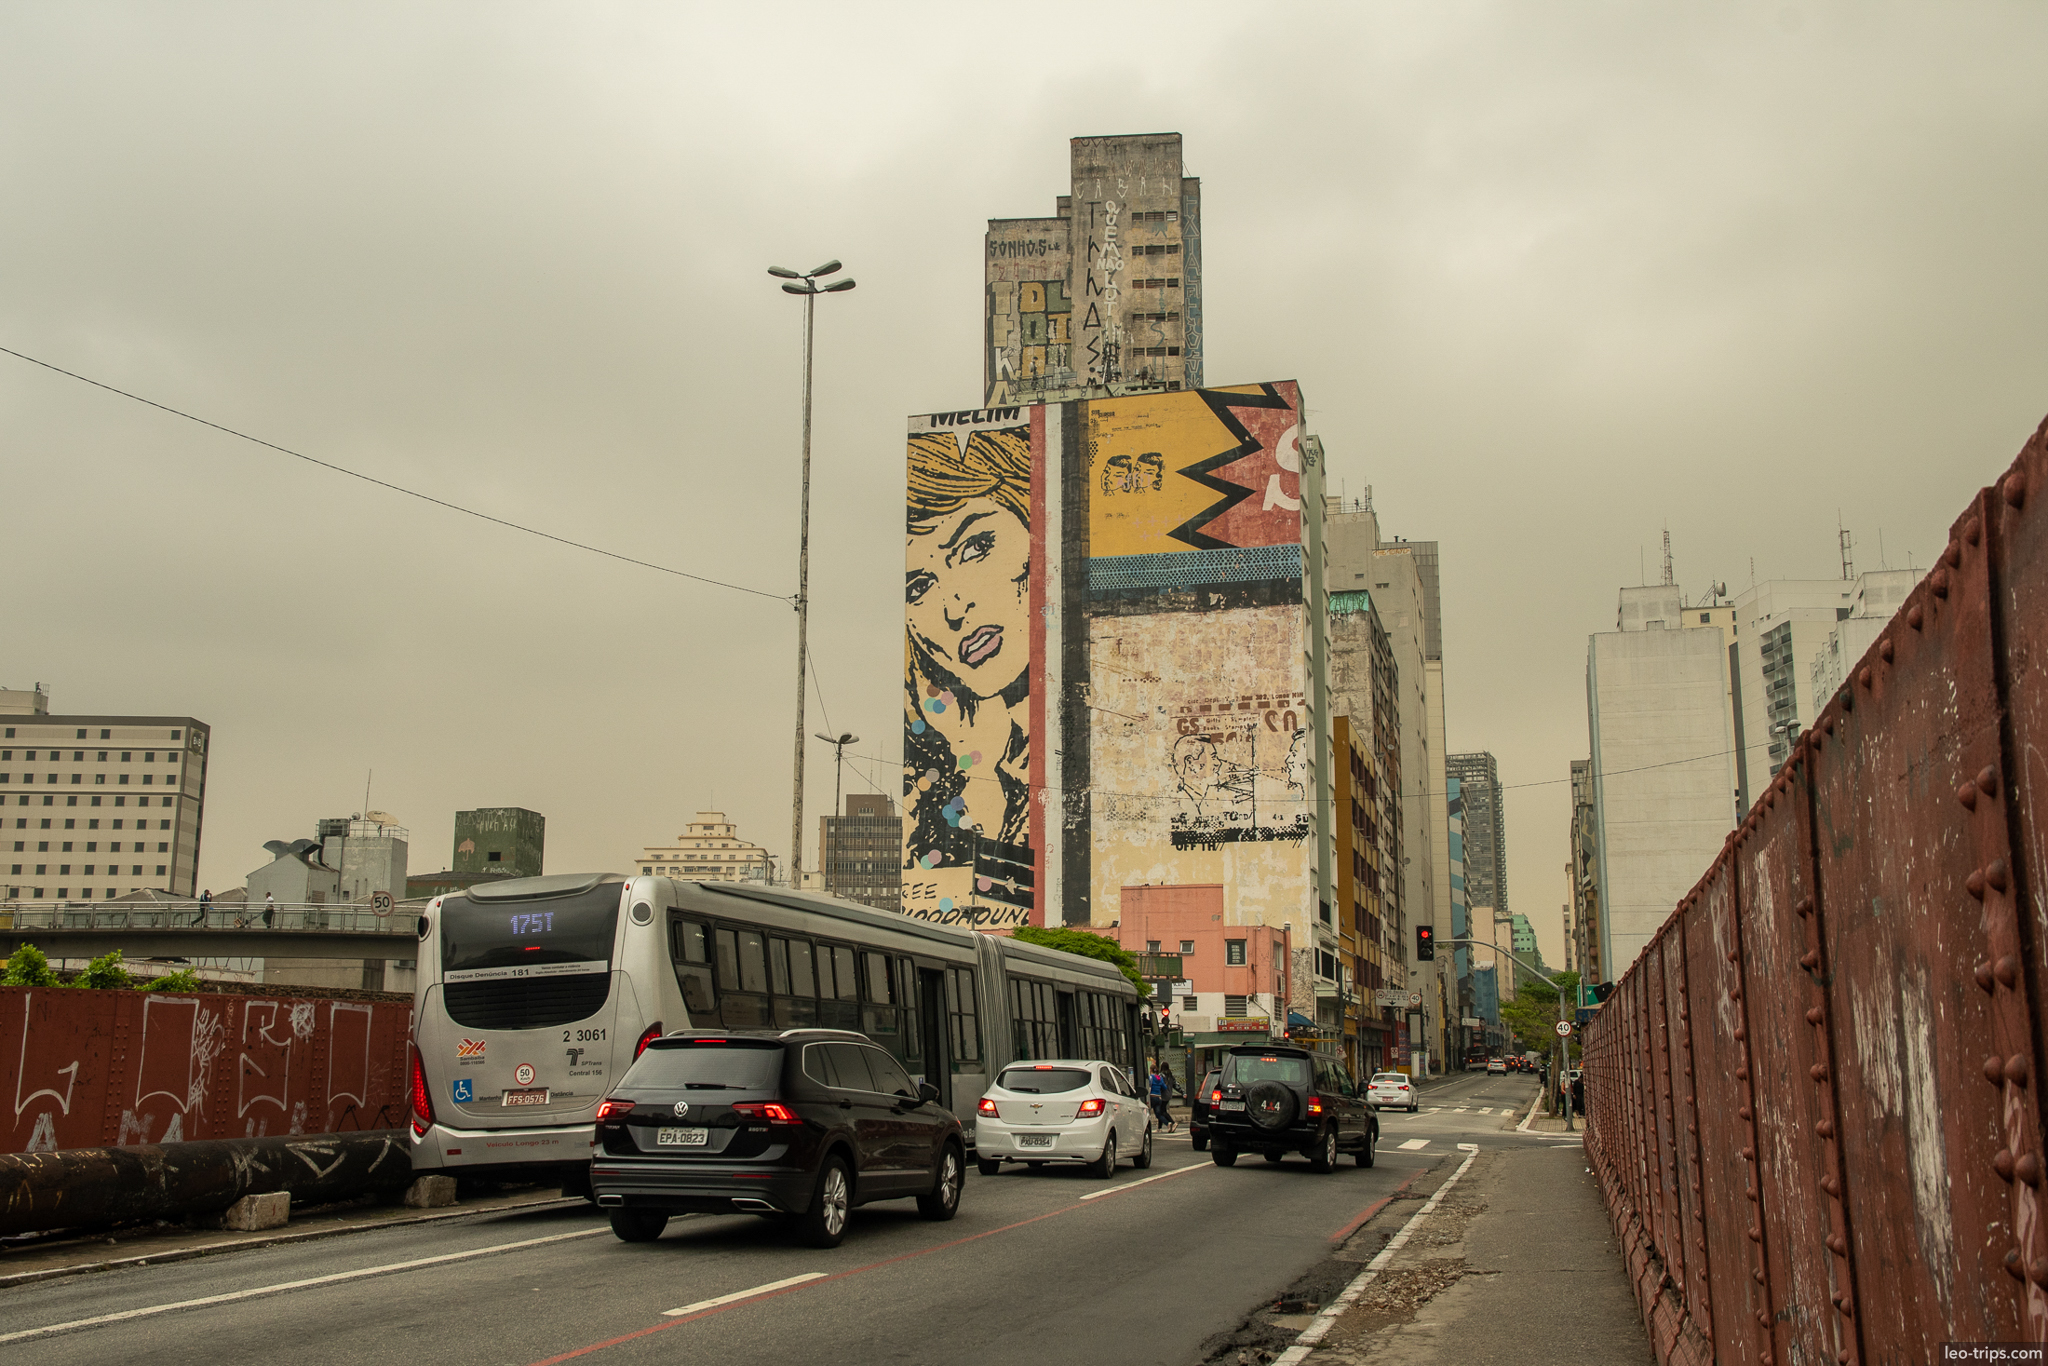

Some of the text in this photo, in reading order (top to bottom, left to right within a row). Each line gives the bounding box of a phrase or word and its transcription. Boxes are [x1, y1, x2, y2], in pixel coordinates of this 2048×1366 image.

[374, 896, 390, 908] 50
[510, 911, 554, 935] 175T
[475, 970, 508, 978] Denúncia
[512, 968, 530, 977] 181
[1557, 1023, 1570, 1032] 40
[563, 1028, 606, 1042] 2 3061
[520, 1068, 530, 1077] 50
[515, 1139, 539, 1147] Longo
[659, 1133, 705, 1144] EPA-0823
